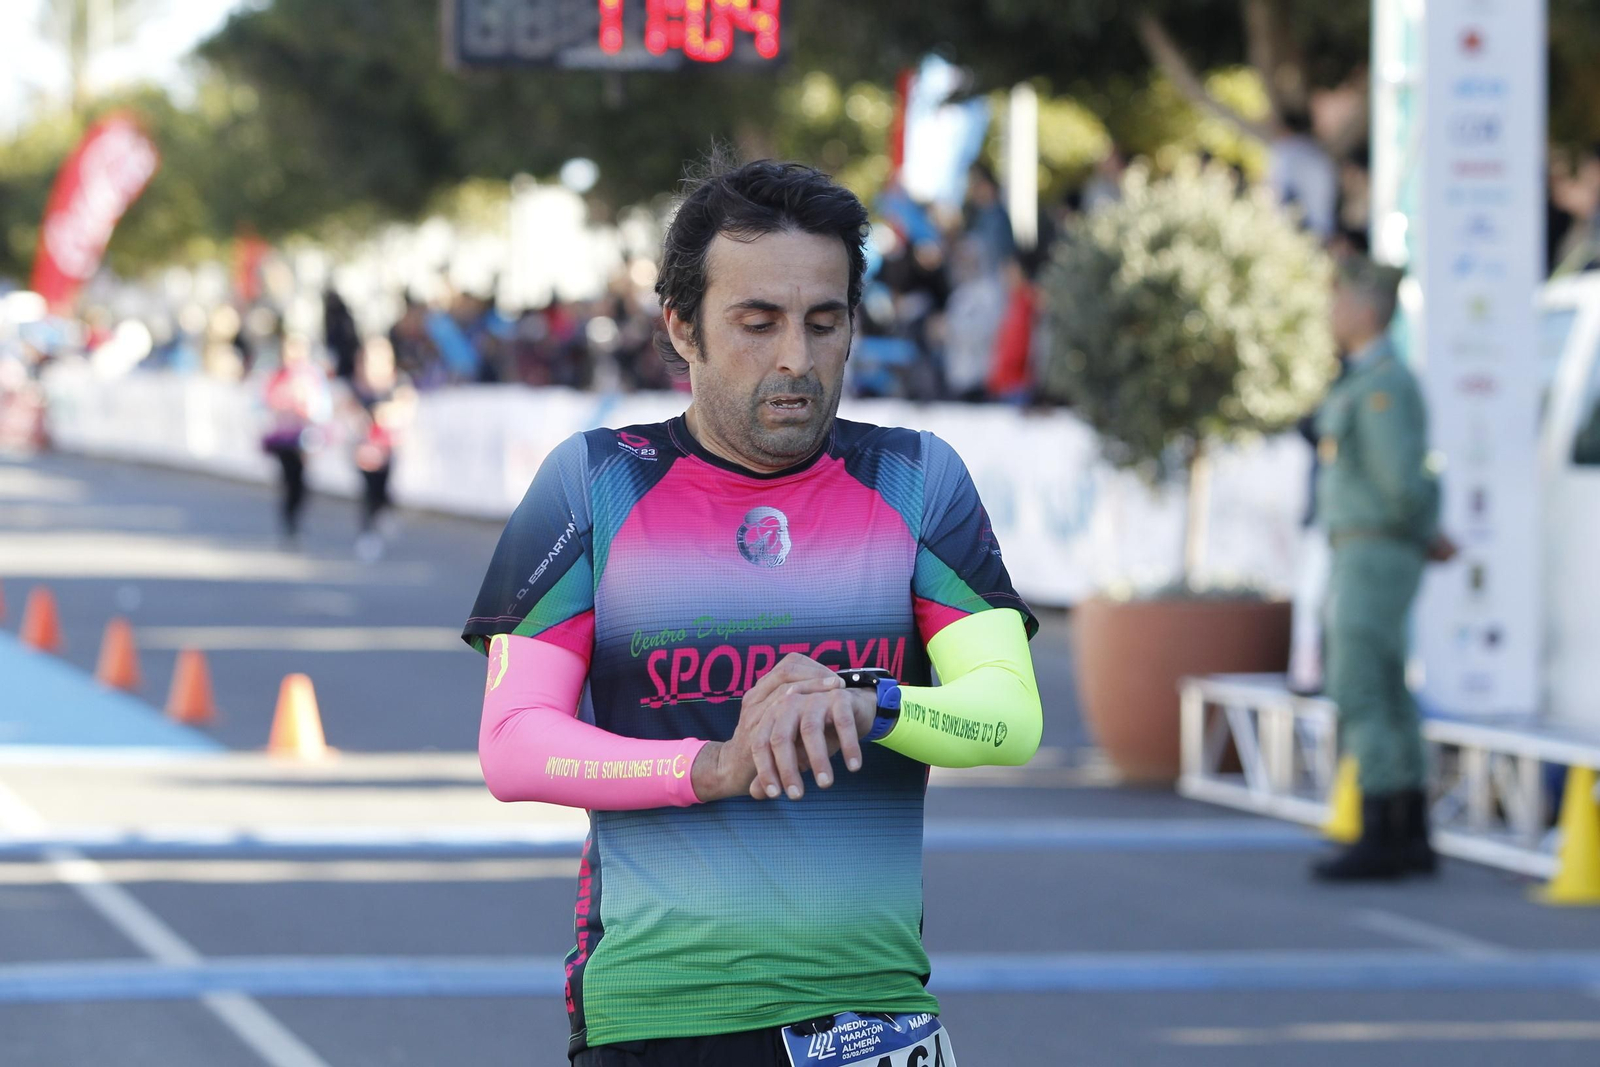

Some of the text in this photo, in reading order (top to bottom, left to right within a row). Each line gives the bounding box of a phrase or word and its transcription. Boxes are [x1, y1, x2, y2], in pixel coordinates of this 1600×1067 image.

[640, 448, 656, 456] 23
[630, 628, 687, 658] Centro
[646, 636, 906, 708] SPORGYM
[928, 708, 940, 730] DEL
[941, 713, 981, 741] ESPARTANOS
[545, 756, 581, 779] ALQUIÁN
[584, 760, 600, 779] DEL
[601, 759, 653, 779] ESPARTANOS
[838, 1019, 868, 1033] MEDIO
[840, 1024, 883, 1043] MARATÓN
[842, 1035, 881, 1053] ALMERÍA
[842, 1046, 875, 1060] 03/02/2019
